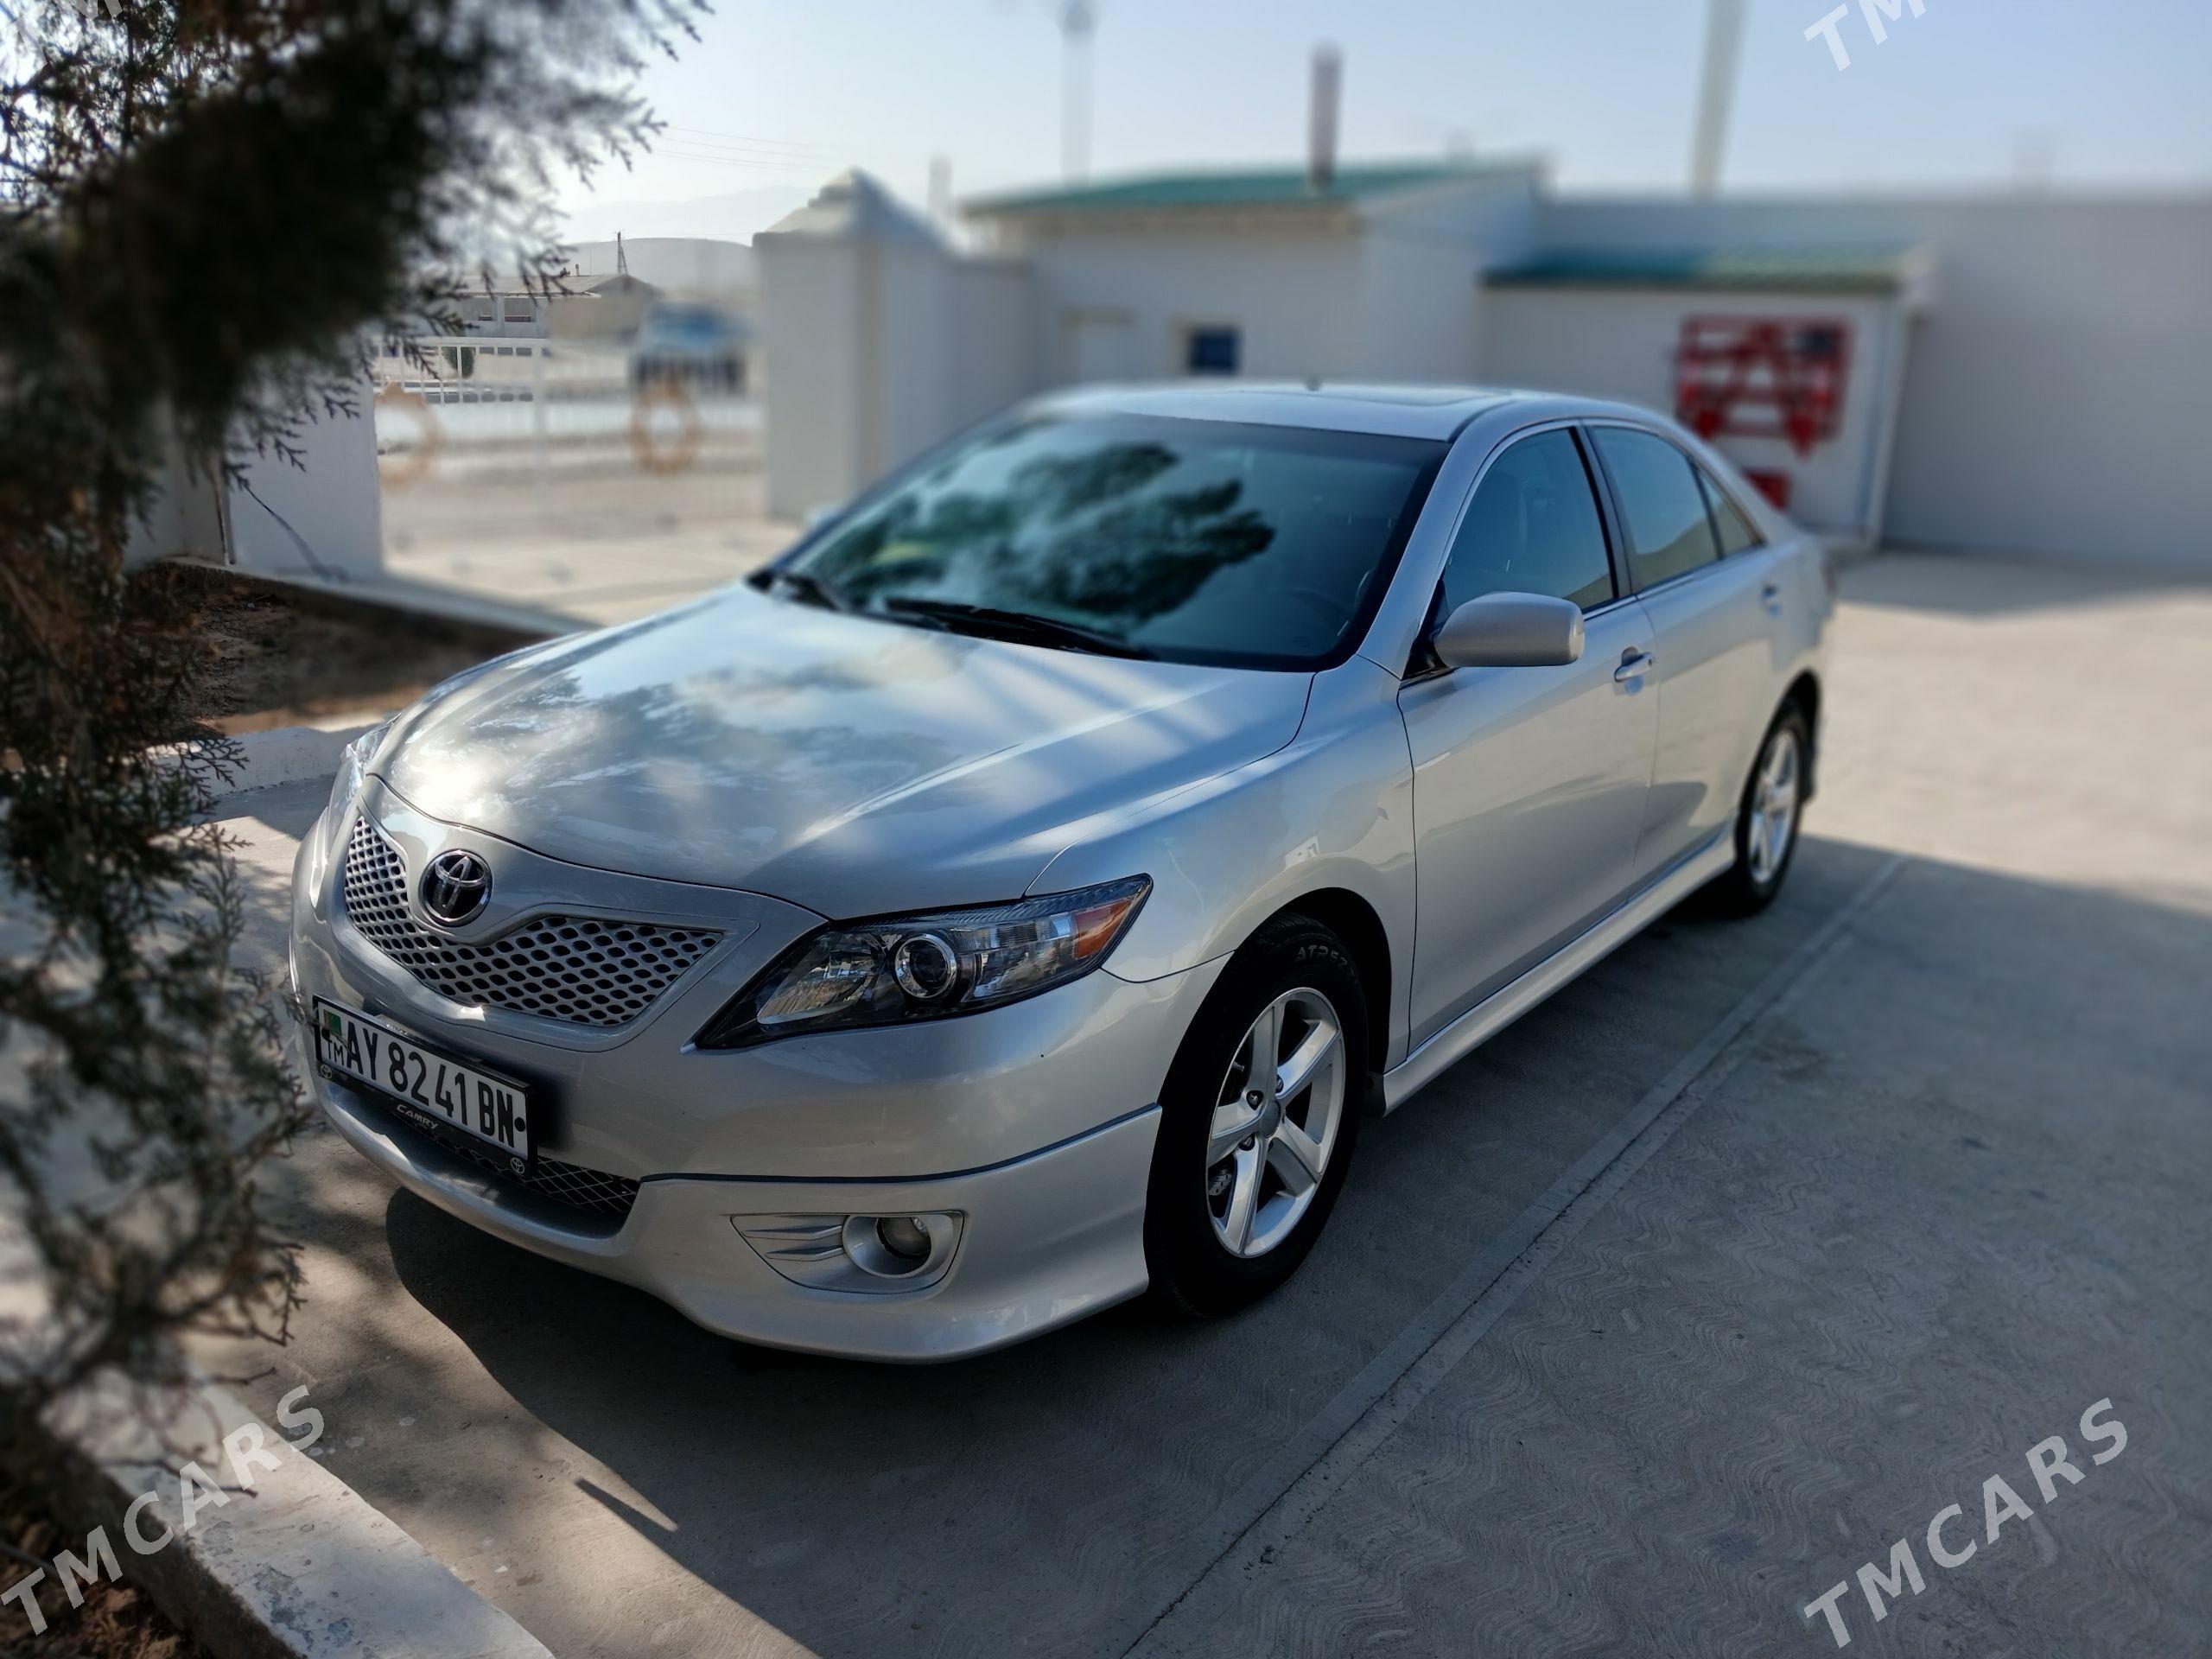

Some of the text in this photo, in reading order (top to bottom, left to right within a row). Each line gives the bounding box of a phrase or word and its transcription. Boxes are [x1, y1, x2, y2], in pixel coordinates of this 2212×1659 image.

[326, 1039, 344, 1067] TM
[346, 1021, 515, 1147] AY 8241 BN
[396, 1103, 439, 1130] CAMRY
